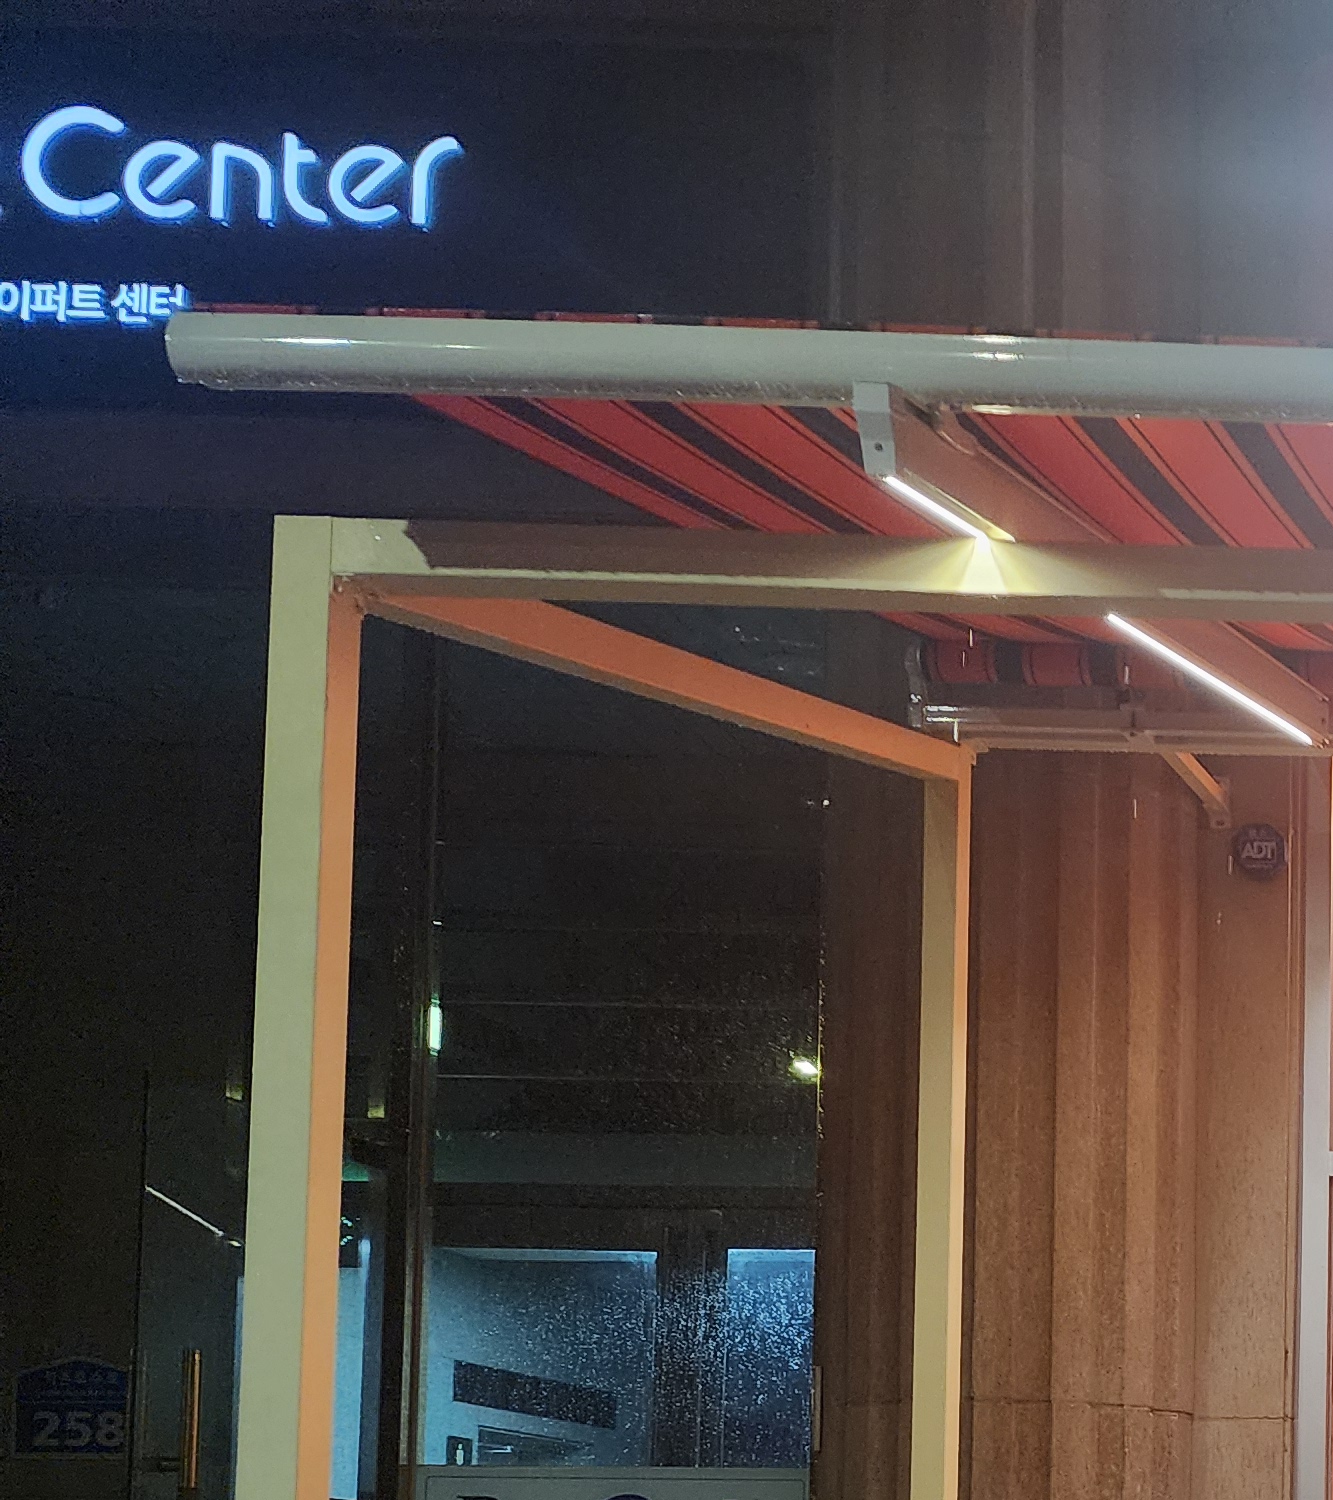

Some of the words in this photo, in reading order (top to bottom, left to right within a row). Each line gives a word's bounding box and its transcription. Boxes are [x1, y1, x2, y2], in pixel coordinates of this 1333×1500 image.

[21, 104, 465, 229] Center
[1241, 841, 1276, 859] ADT
[33, 1411, 124, 1447] 258
